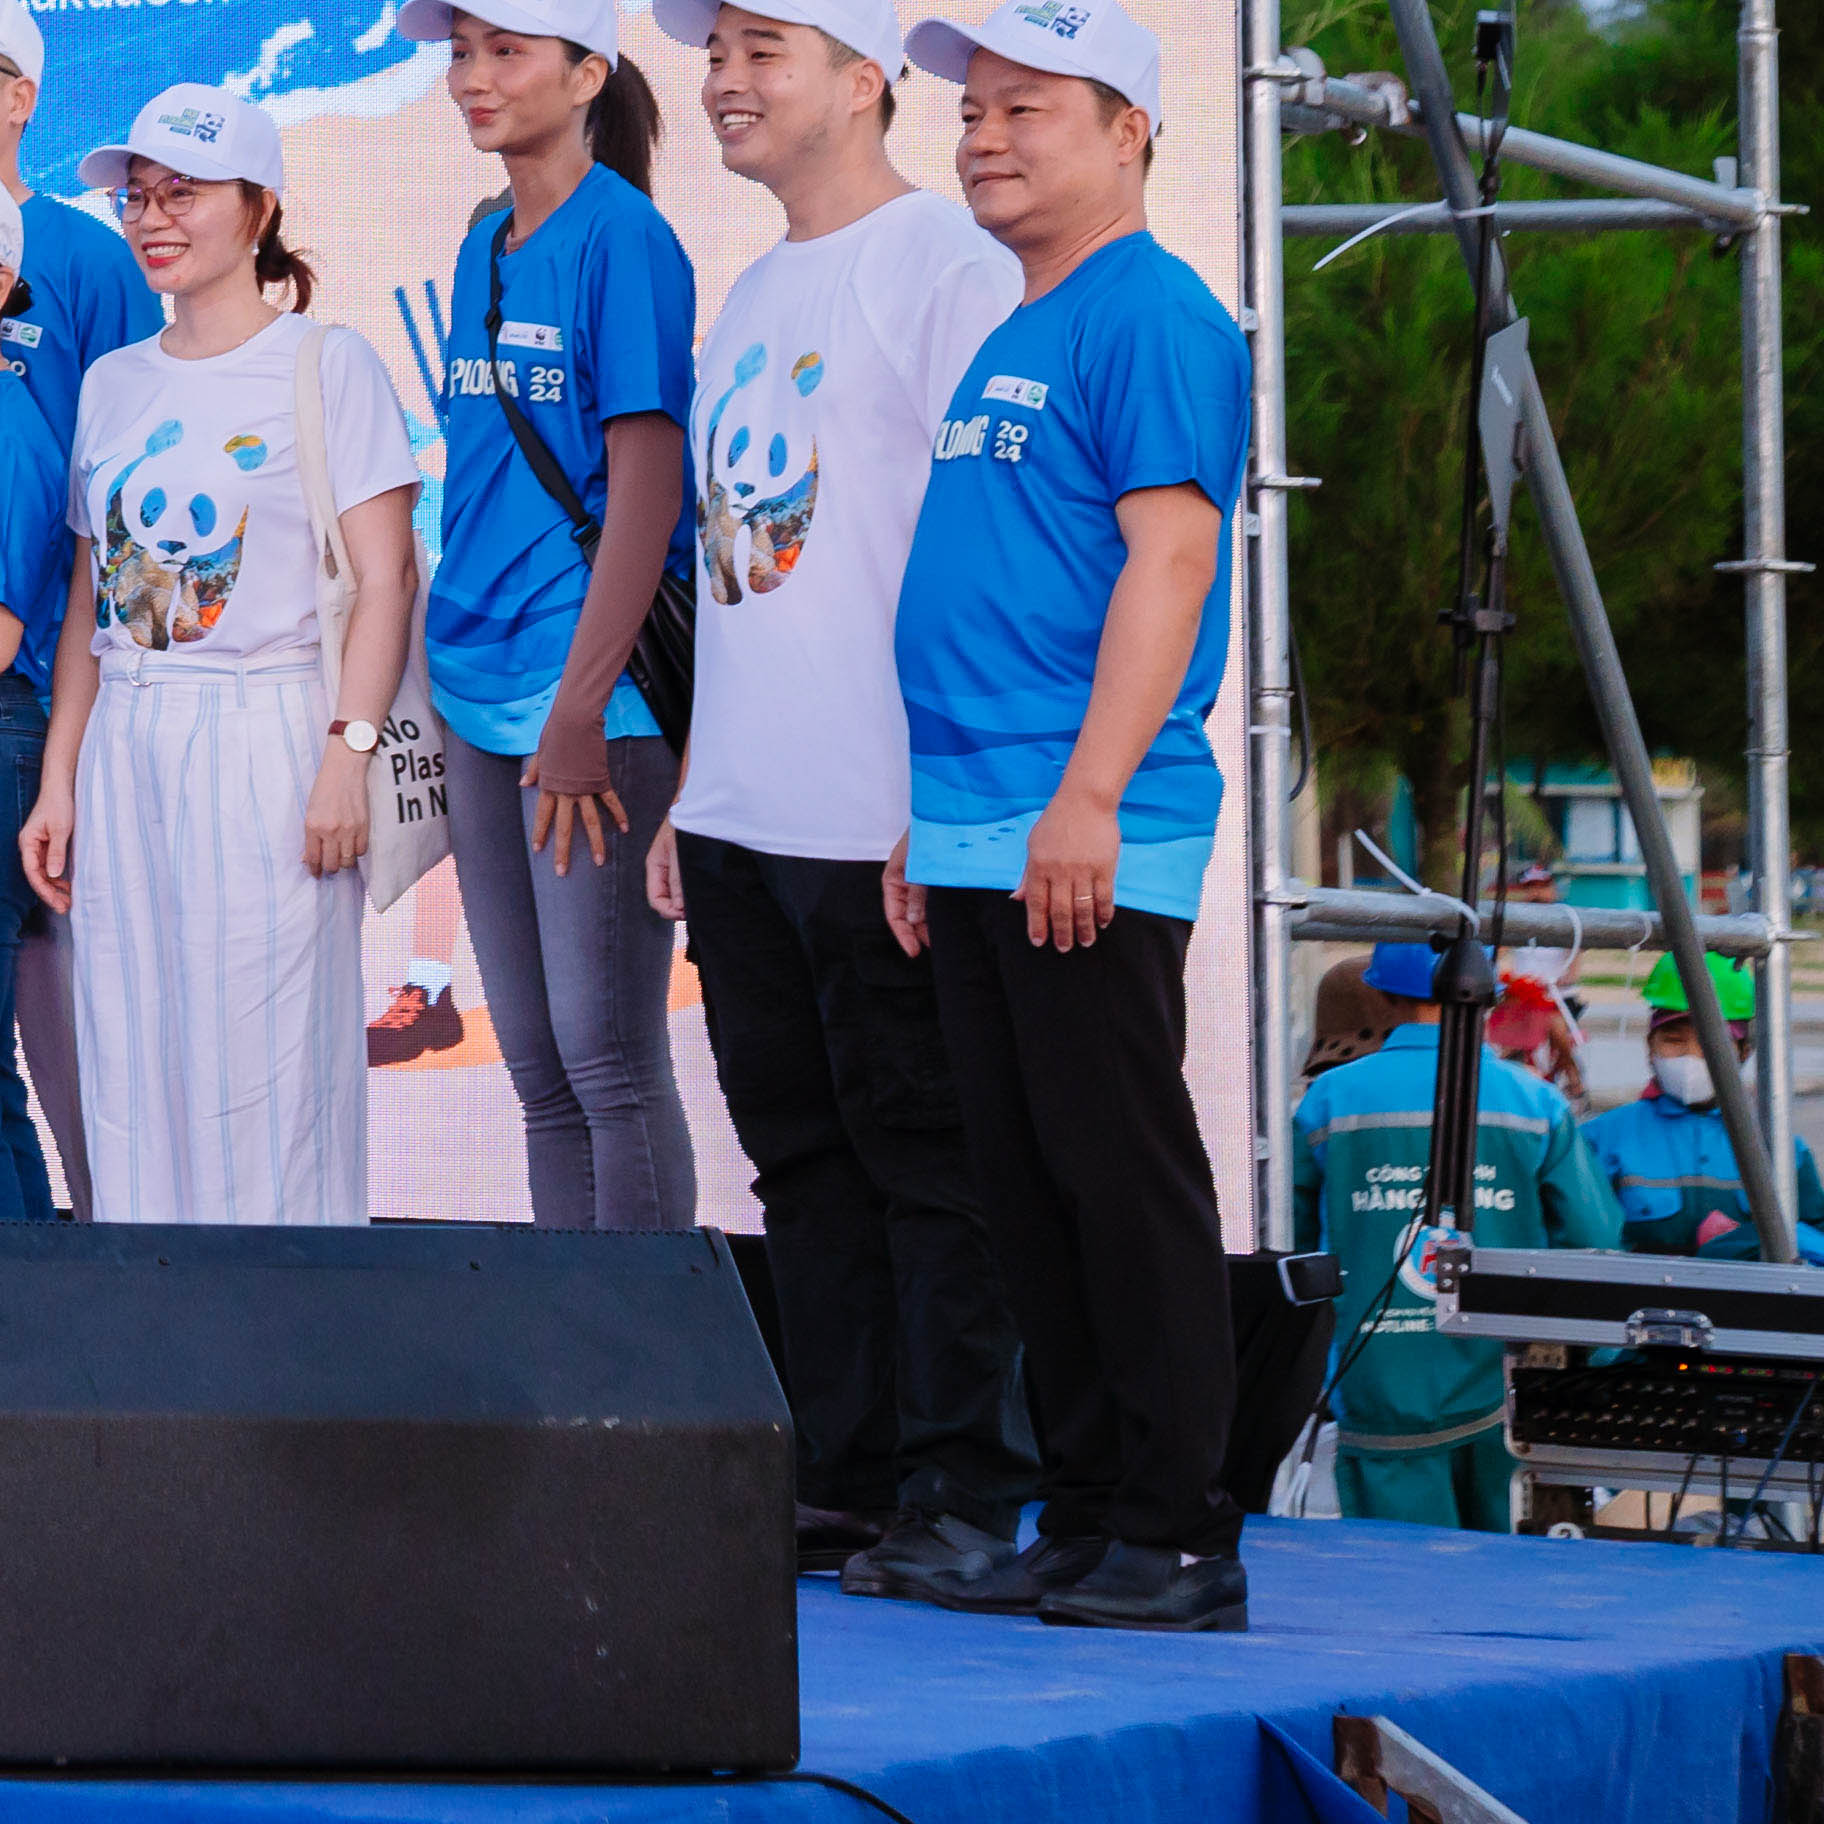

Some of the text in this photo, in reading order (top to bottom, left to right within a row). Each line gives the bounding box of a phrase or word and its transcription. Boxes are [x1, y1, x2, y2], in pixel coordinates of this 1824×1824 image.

[530, 366, 565, 385] 20
[529, 383, 563, 403] 24
[996, 419, 1029, 444] 20
[994, 439, 1023, 463] 24
[378, 715, 420, 749] No
[397, 791, 423, 825] In
